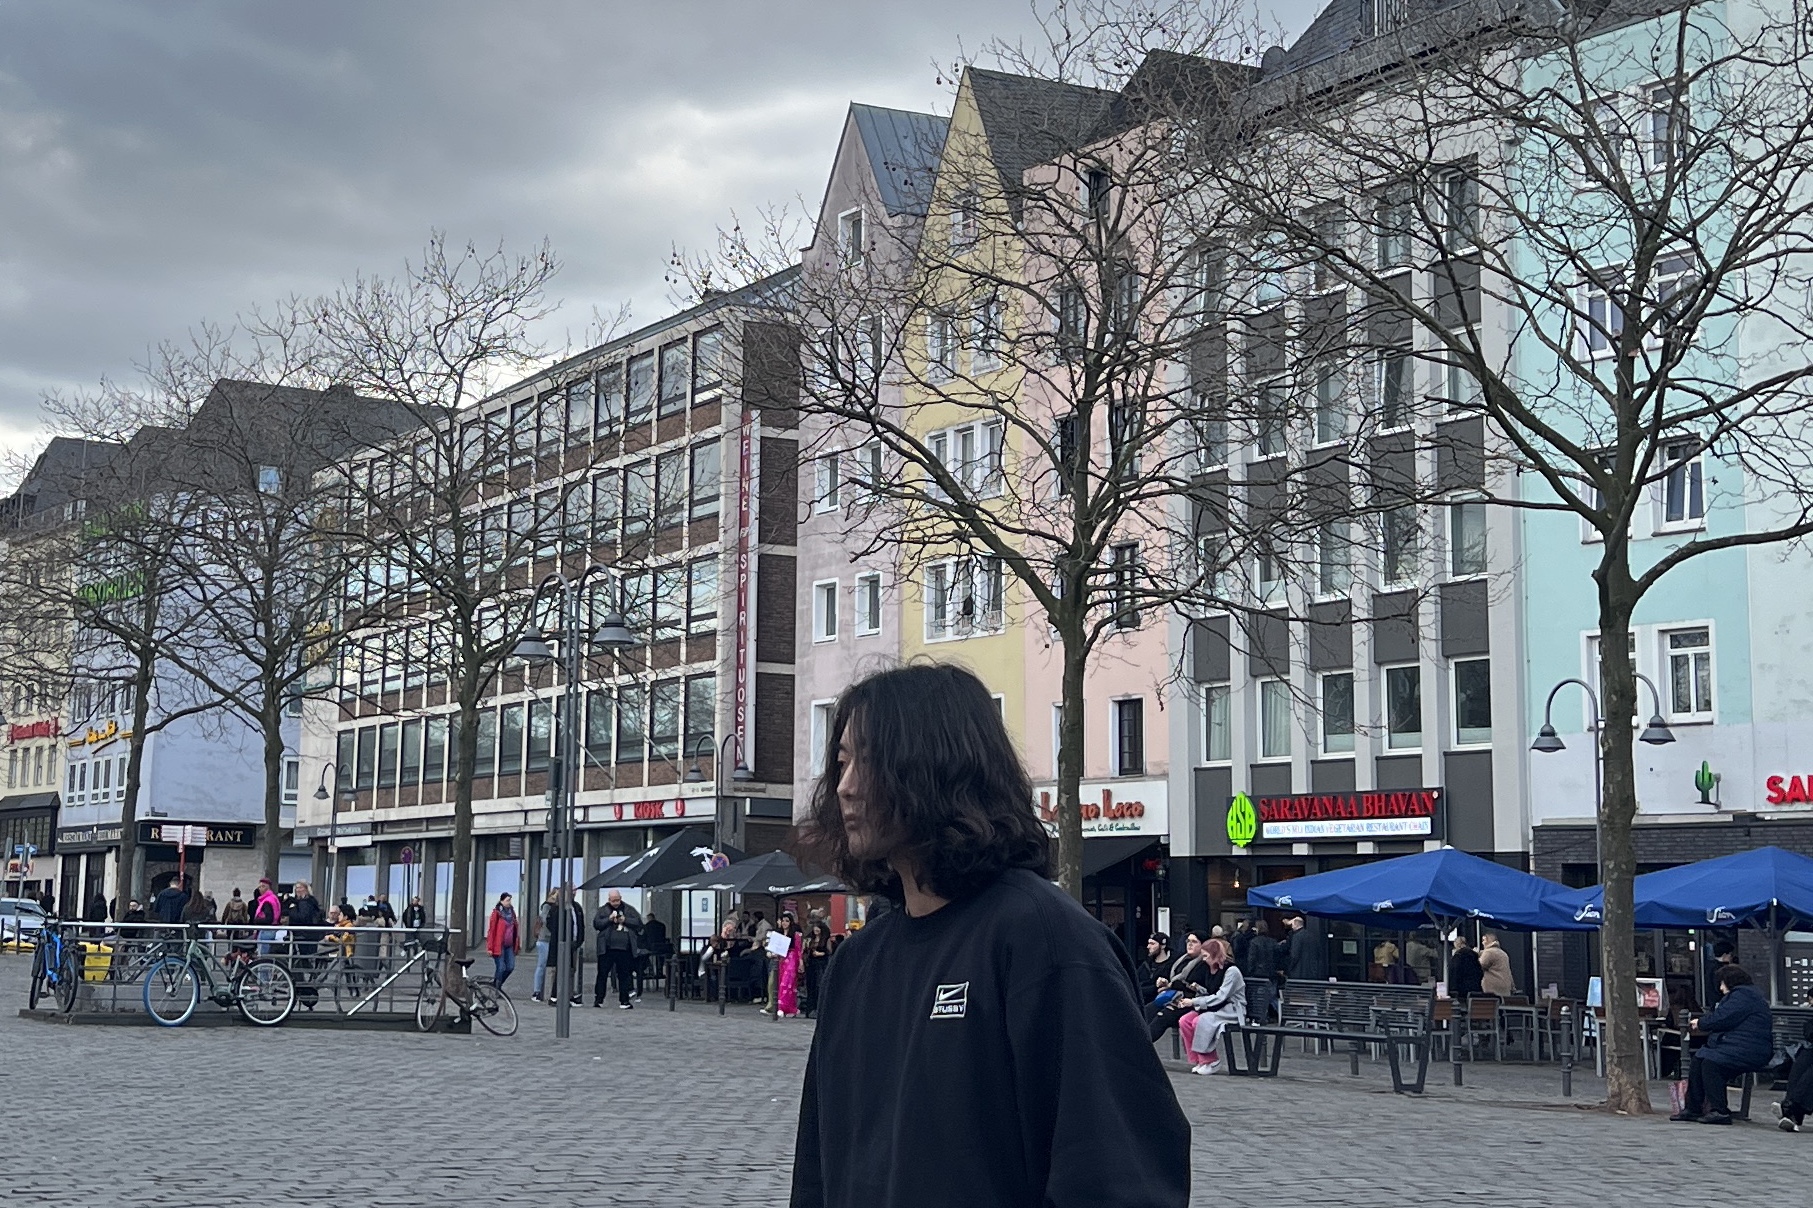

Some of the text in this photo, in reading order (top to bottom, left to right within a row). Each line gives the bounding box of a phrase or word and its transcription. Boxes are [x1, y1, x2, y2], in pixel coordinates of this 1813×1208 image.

[741, 423, 751, 511] WEINE
[736, 553, 747, 761] SPIRITUOSEN
[634, 801, 664, 819] KIOSK
[1102, 788, 1144, 820] Loco
[1259, 790, 1435, 821] SARAVANAA BHAVAN
[150, 827, 244, 842] RRANT
